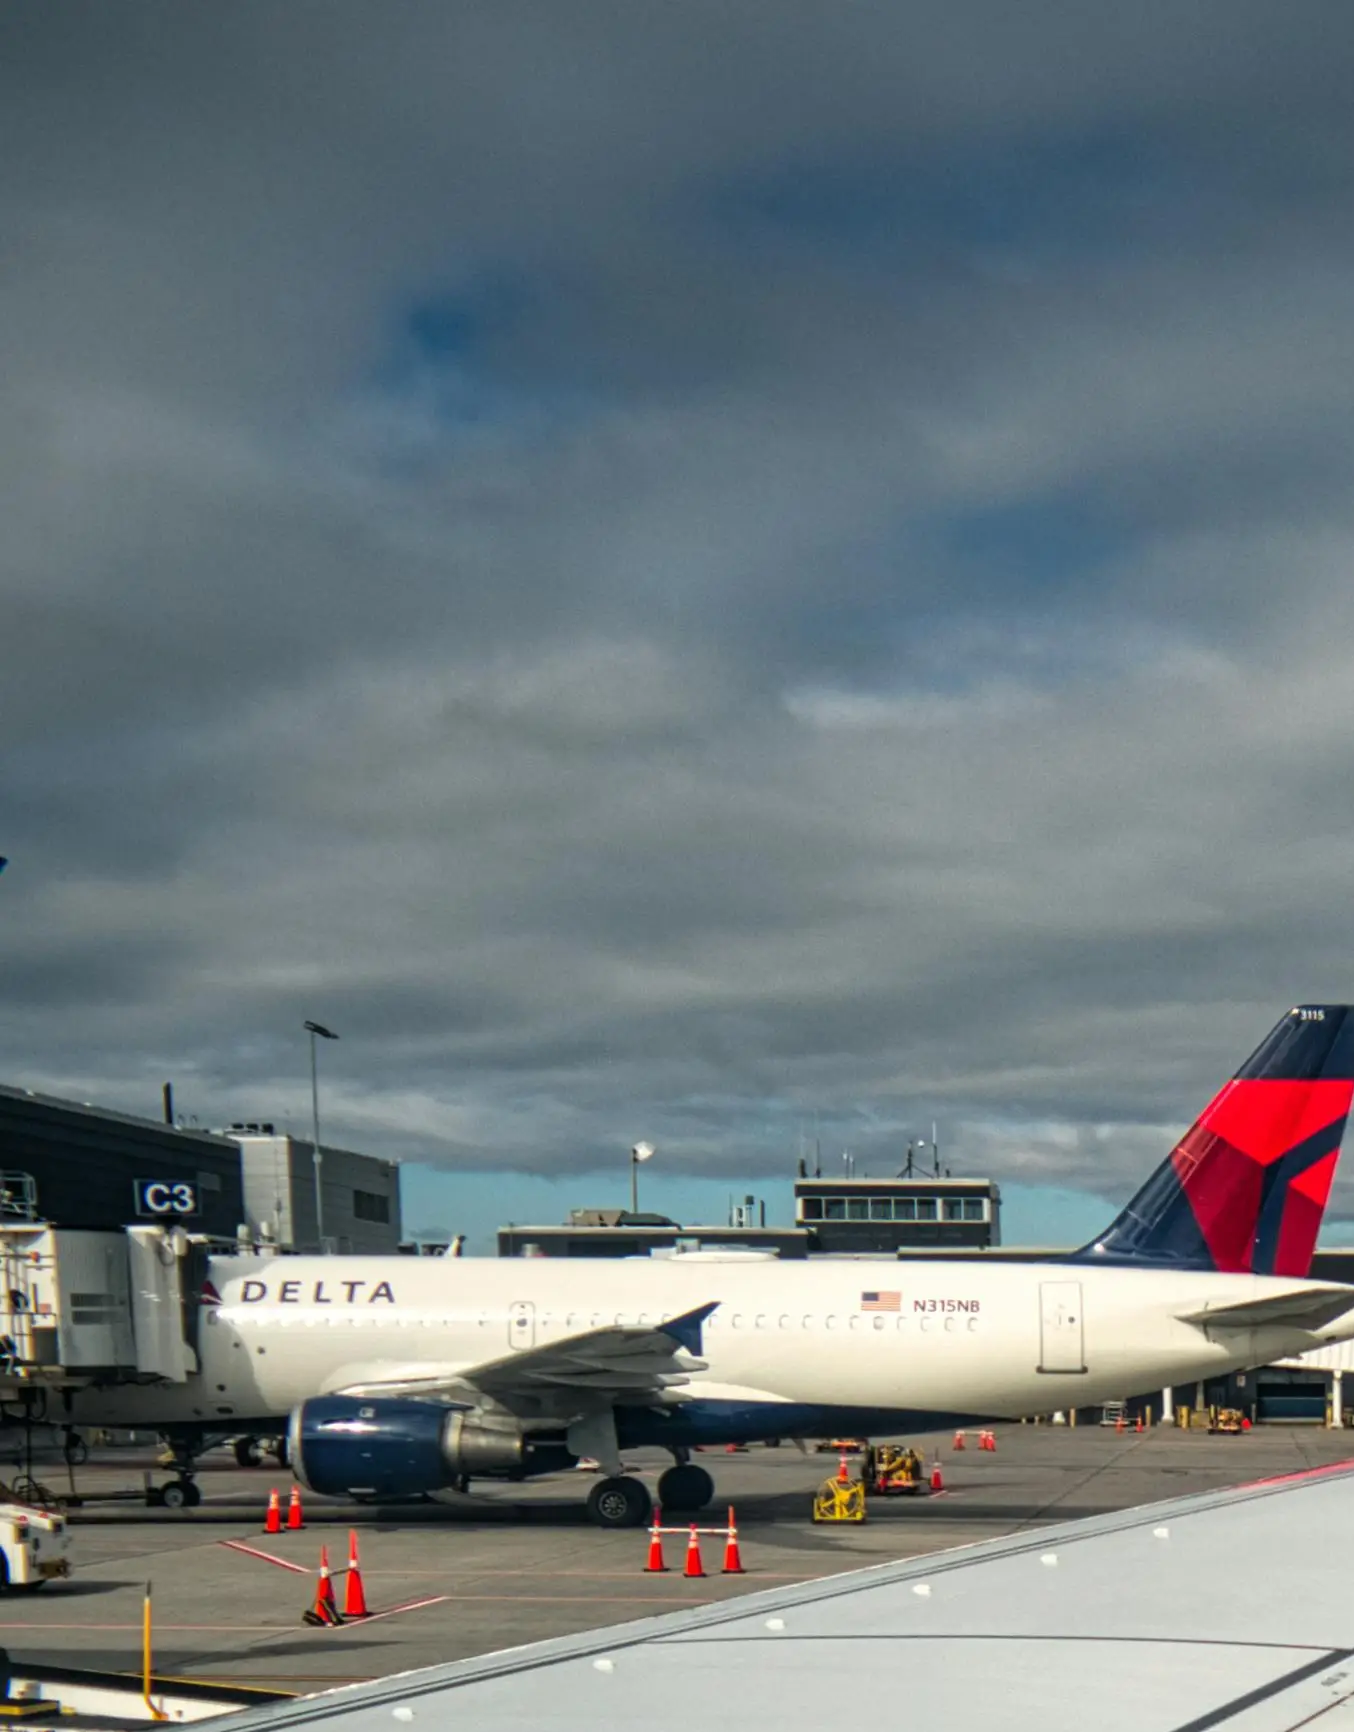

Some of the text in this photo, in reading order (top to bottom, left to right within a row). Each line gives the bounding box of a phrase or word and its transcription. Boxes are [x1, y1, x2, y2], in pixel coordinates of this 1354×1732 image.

[145, 1183, 195, 1212] C3
[240, 1280, 396, 1303] DELTA
[913, 1299, 980, 1313] N315NB
